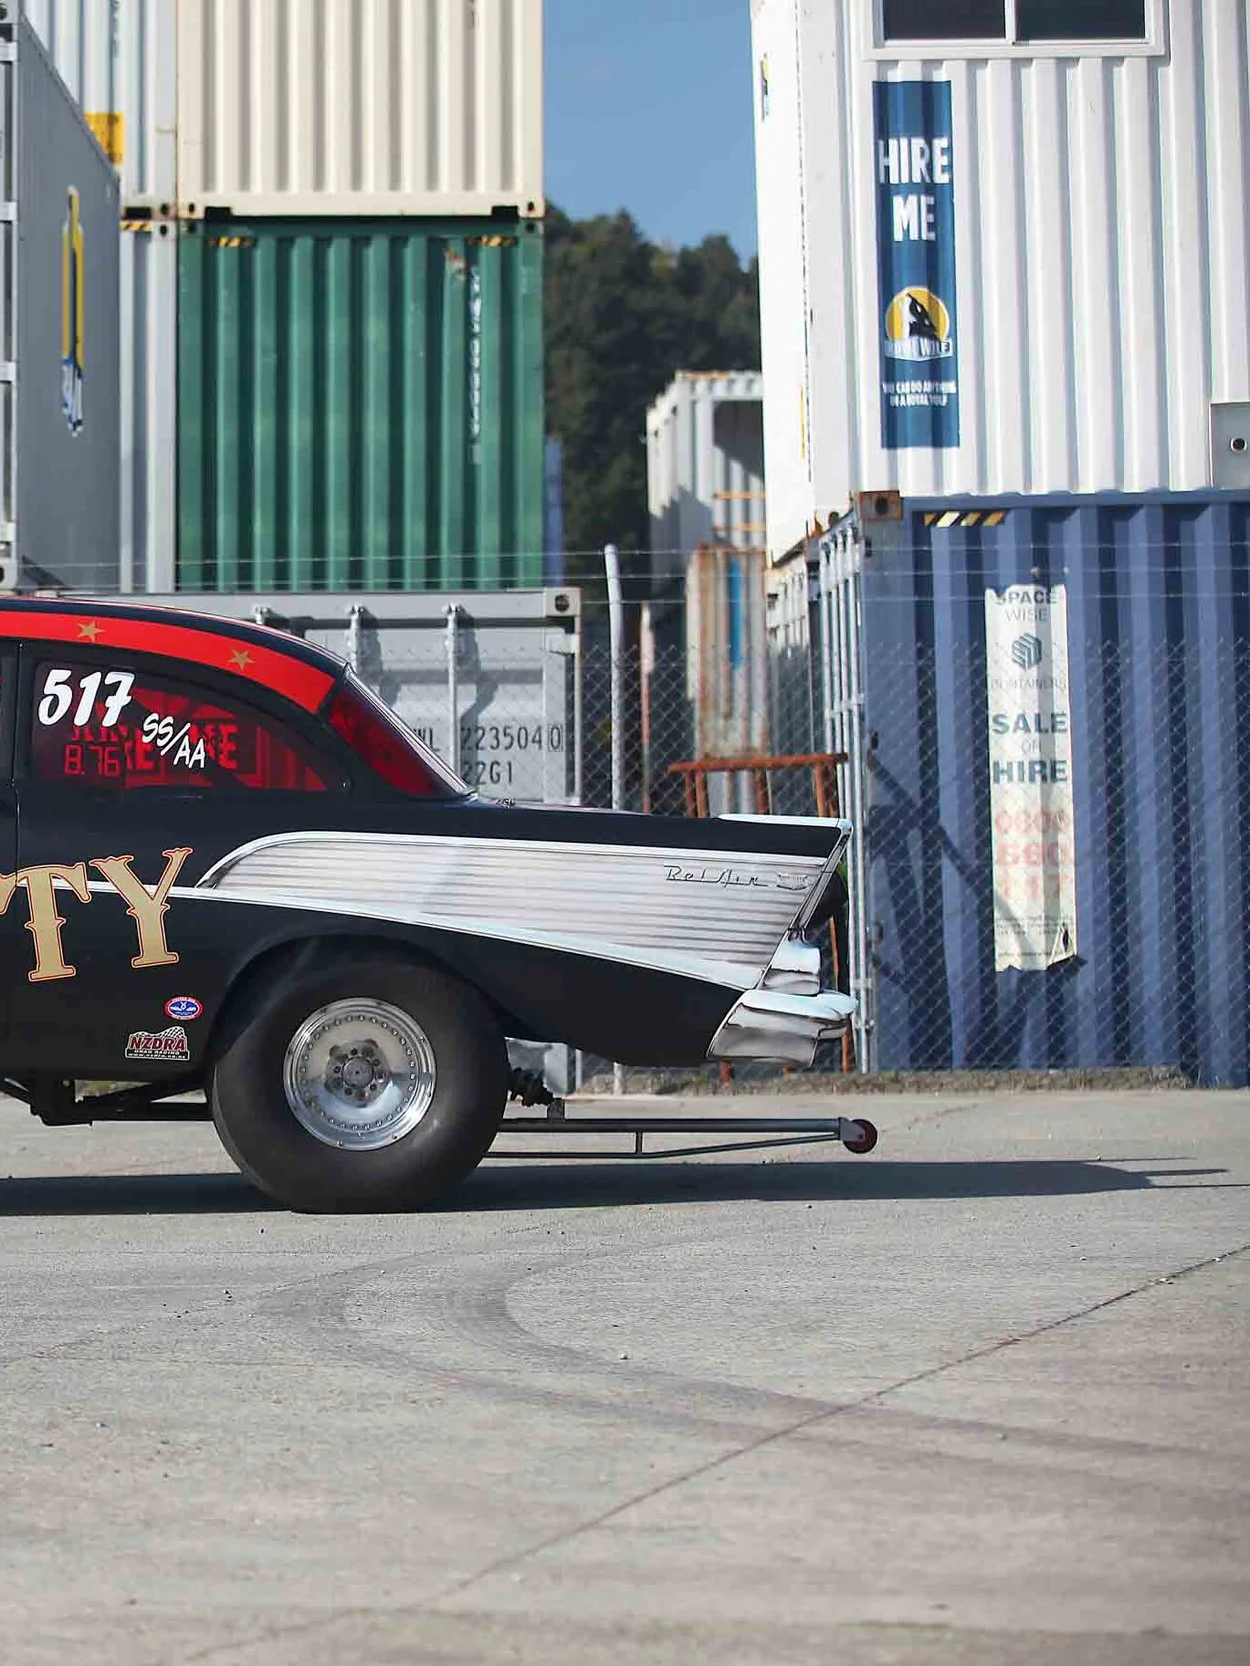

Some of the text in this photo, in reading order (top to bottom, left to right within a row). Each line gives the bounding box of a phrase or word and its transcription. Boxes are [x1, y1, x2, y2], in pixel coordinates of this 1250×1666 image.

[877, 136, 950, 184] HIRE
[892, 193, 937, 242] ME
[1005, 608, 1048, 622] WISE
[37, 668, 136, 728] 517
[992, 712, 1068, 734] SALE
[141, 711, 206, 769] SS/AA
[460, 726, 543, 751] 223504
[992, 760, 1068, 784] HIRE
[129, 1035, 187, 1051] NZDRA
